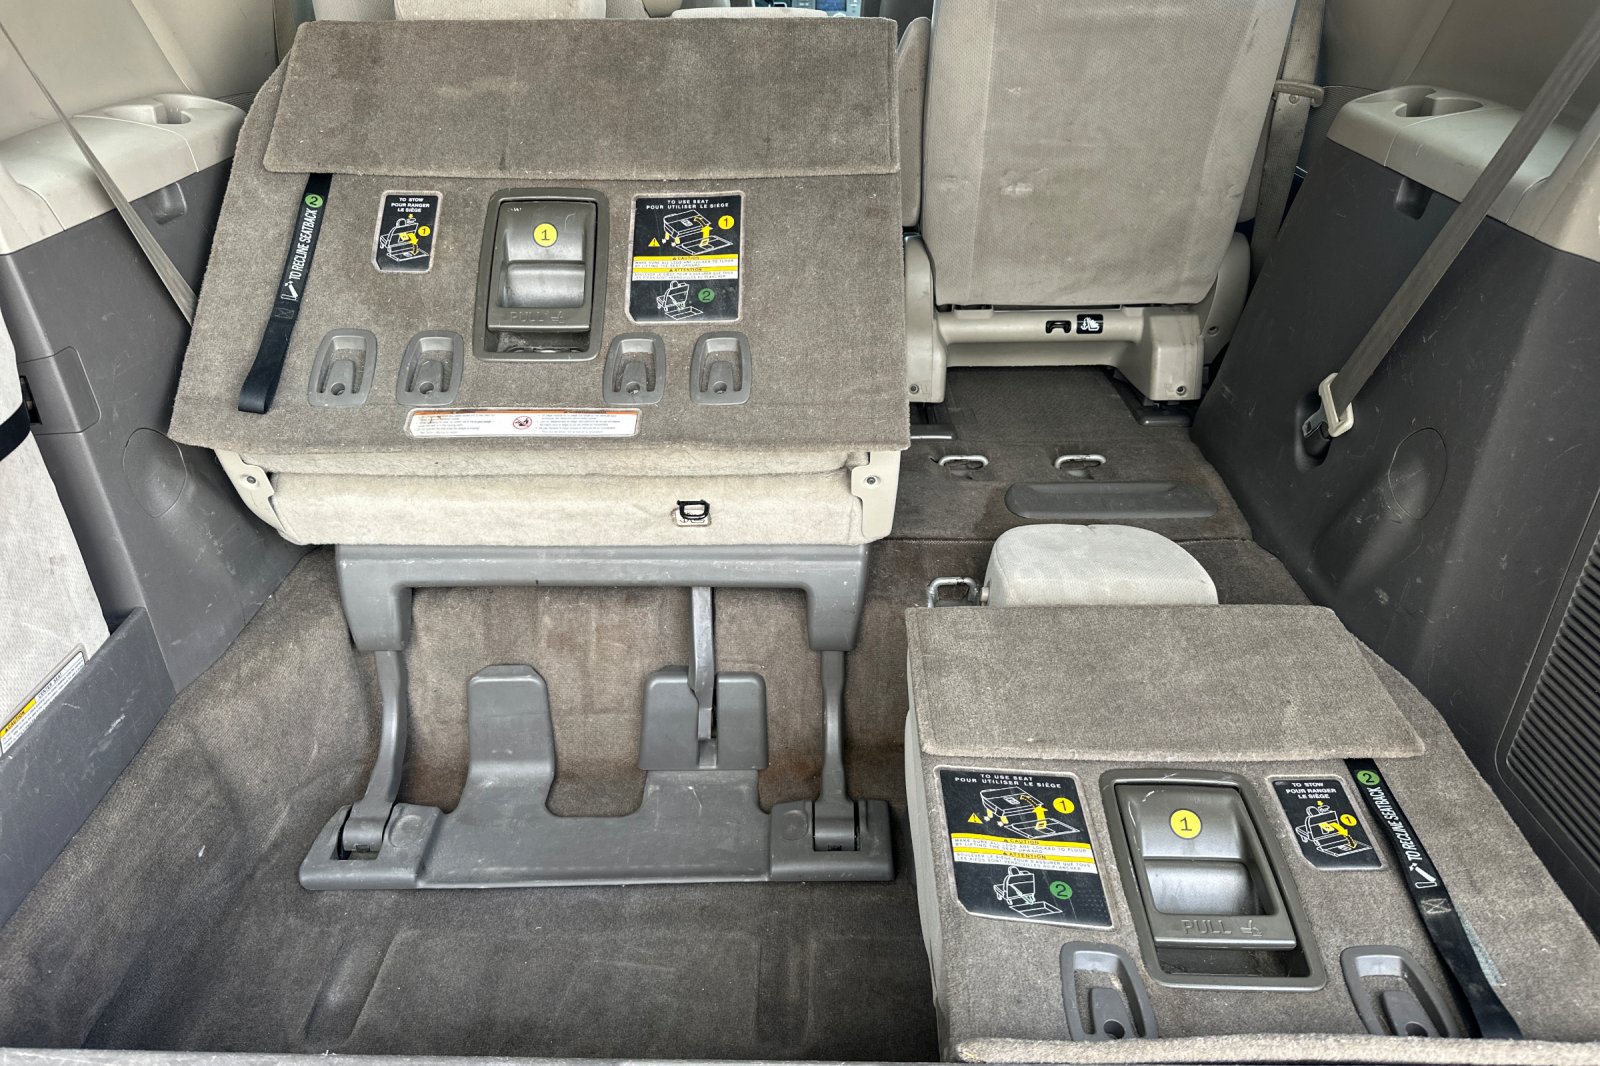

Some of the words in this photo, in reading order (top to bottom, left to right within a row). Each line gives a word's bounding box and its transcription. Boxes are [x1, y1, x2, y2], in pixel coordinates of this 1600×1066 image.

[309, 196, 318, 206] 2
[299, 208, 318, 243] SEATBACK
[541, 230, 550, 240] 1
[292, 243, 310, 272] RECLINE
[289, 271, 302, 280] TO
[703, 290, 710, 300] 2
[510, 311, 544, 322] PULL
[1362, 773, 1375, 783] 2
[1059, 800, 1066, 811] 1
[1367, 787, 1399, 821] SEATBACK
[1180, 817, 1192, 831] 1
[1388, 820, 1417, 850] RECLINE
[1405, 850, 1423, 861] TO
[1056, 884, 1068, 897] 2
[1181, 920, 1232, 934] PULL
